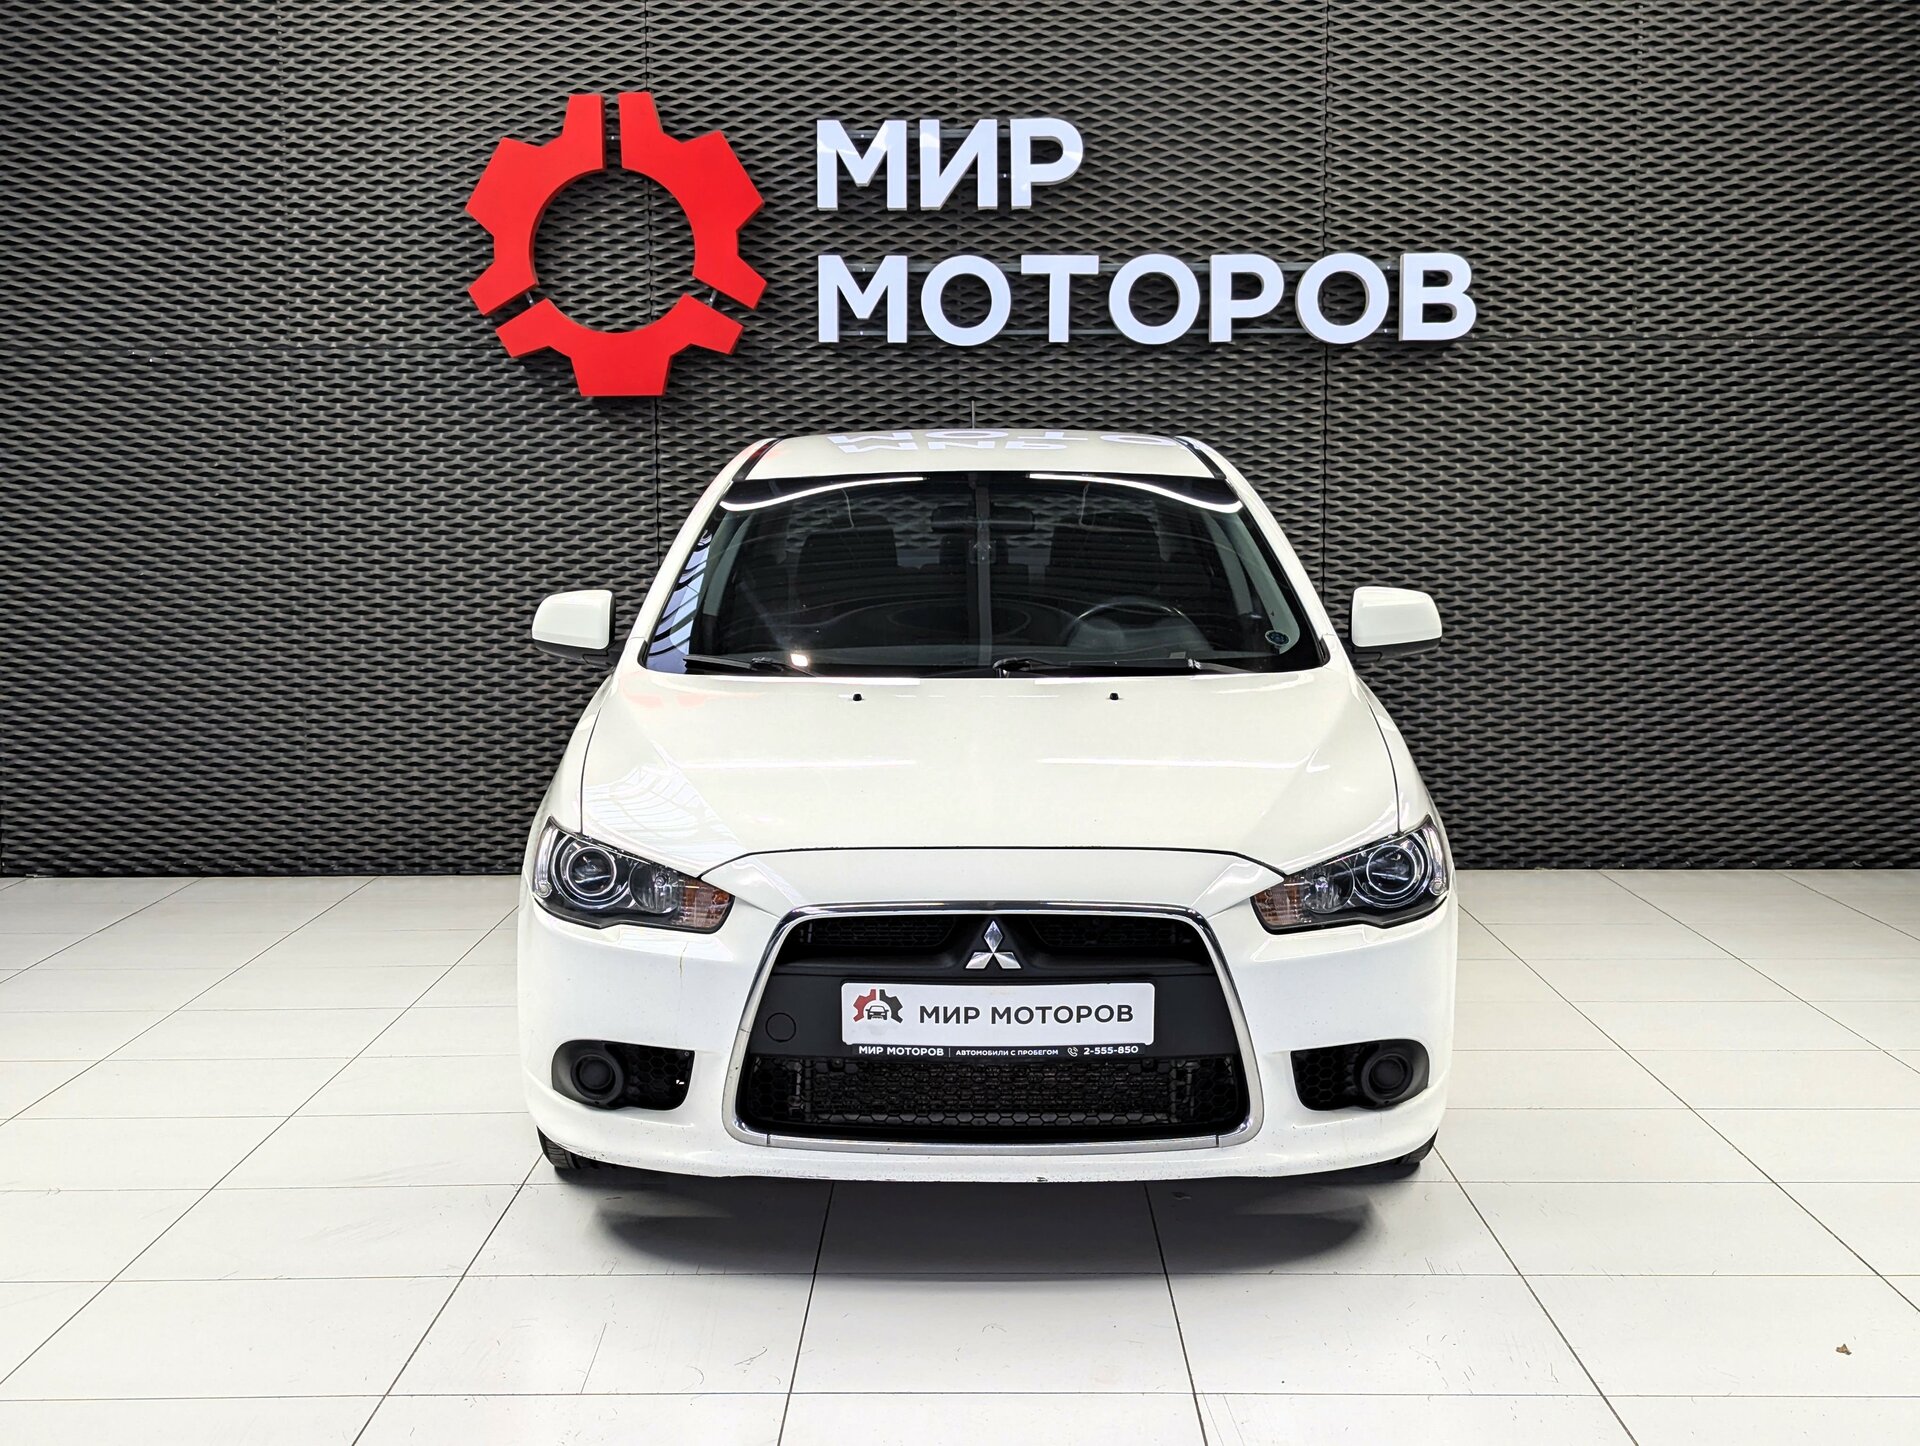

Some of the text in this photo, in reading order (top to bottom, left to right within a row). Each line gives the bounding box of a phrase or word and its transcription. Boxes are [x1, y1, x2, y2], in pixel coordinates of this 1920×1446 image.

[816, 118, 1084, 210] МИР
[817, 252, 1477, 346] МОТОРОВ
[919, 1004, 1134, 1025] МИР МОТОРОВ
[858, 1045, 884, 1055] МИР
[886, 1046, 945, 1057] МОТОРОВ
[1083, 1045, 1139, 1056] 2-555-850
